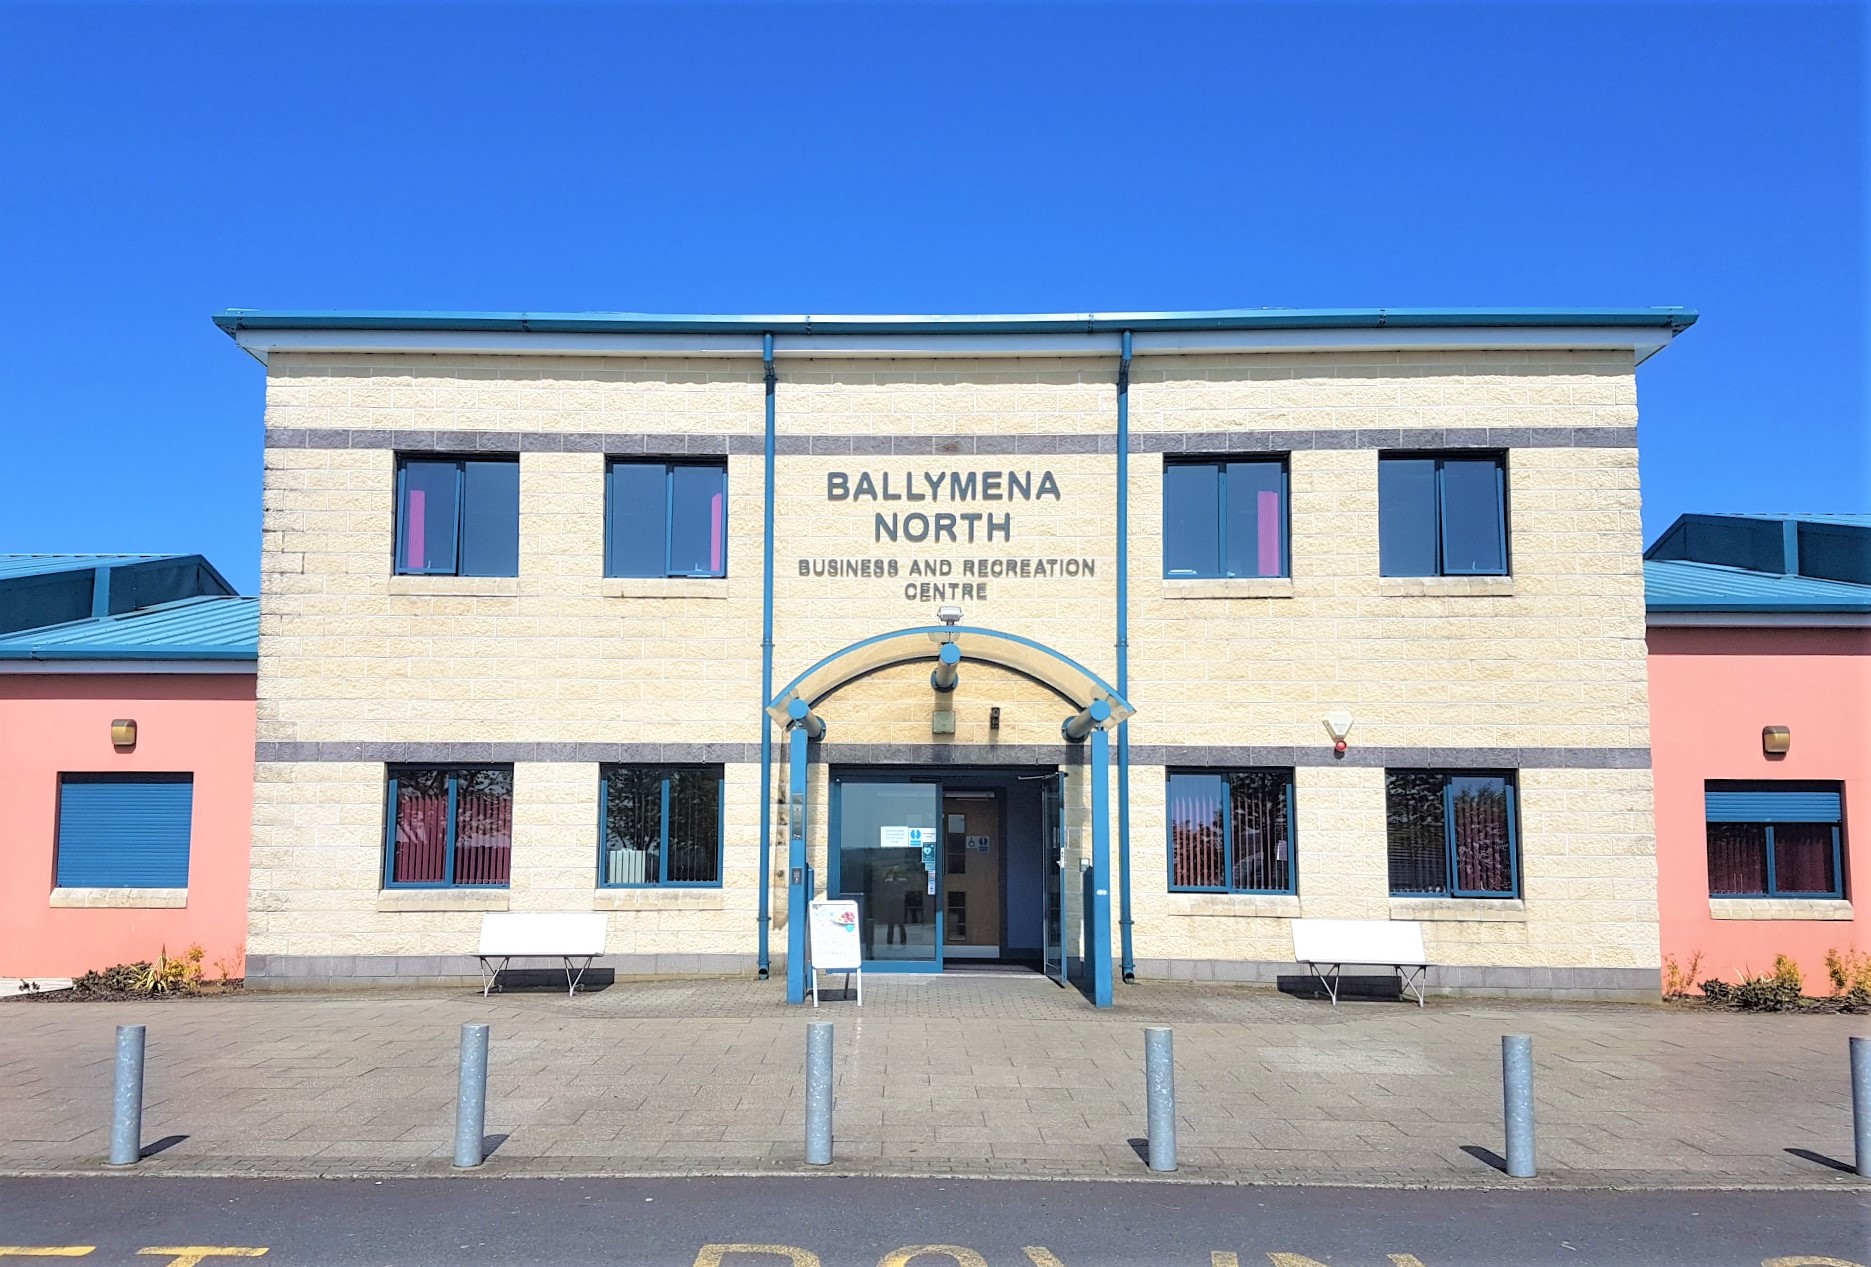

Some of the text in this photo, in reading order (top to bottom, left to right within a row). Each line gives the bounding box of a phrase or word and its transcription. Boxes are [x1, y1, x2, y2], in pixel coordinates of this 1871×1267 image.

[827, 471, 1061, 502] BALLYMENA
[875, 512, 1011, 543] NORTH
[798, 559, 1096, 578] BUSINESS AND RECREATION
[904, 582, 988, 602] CENTRE
